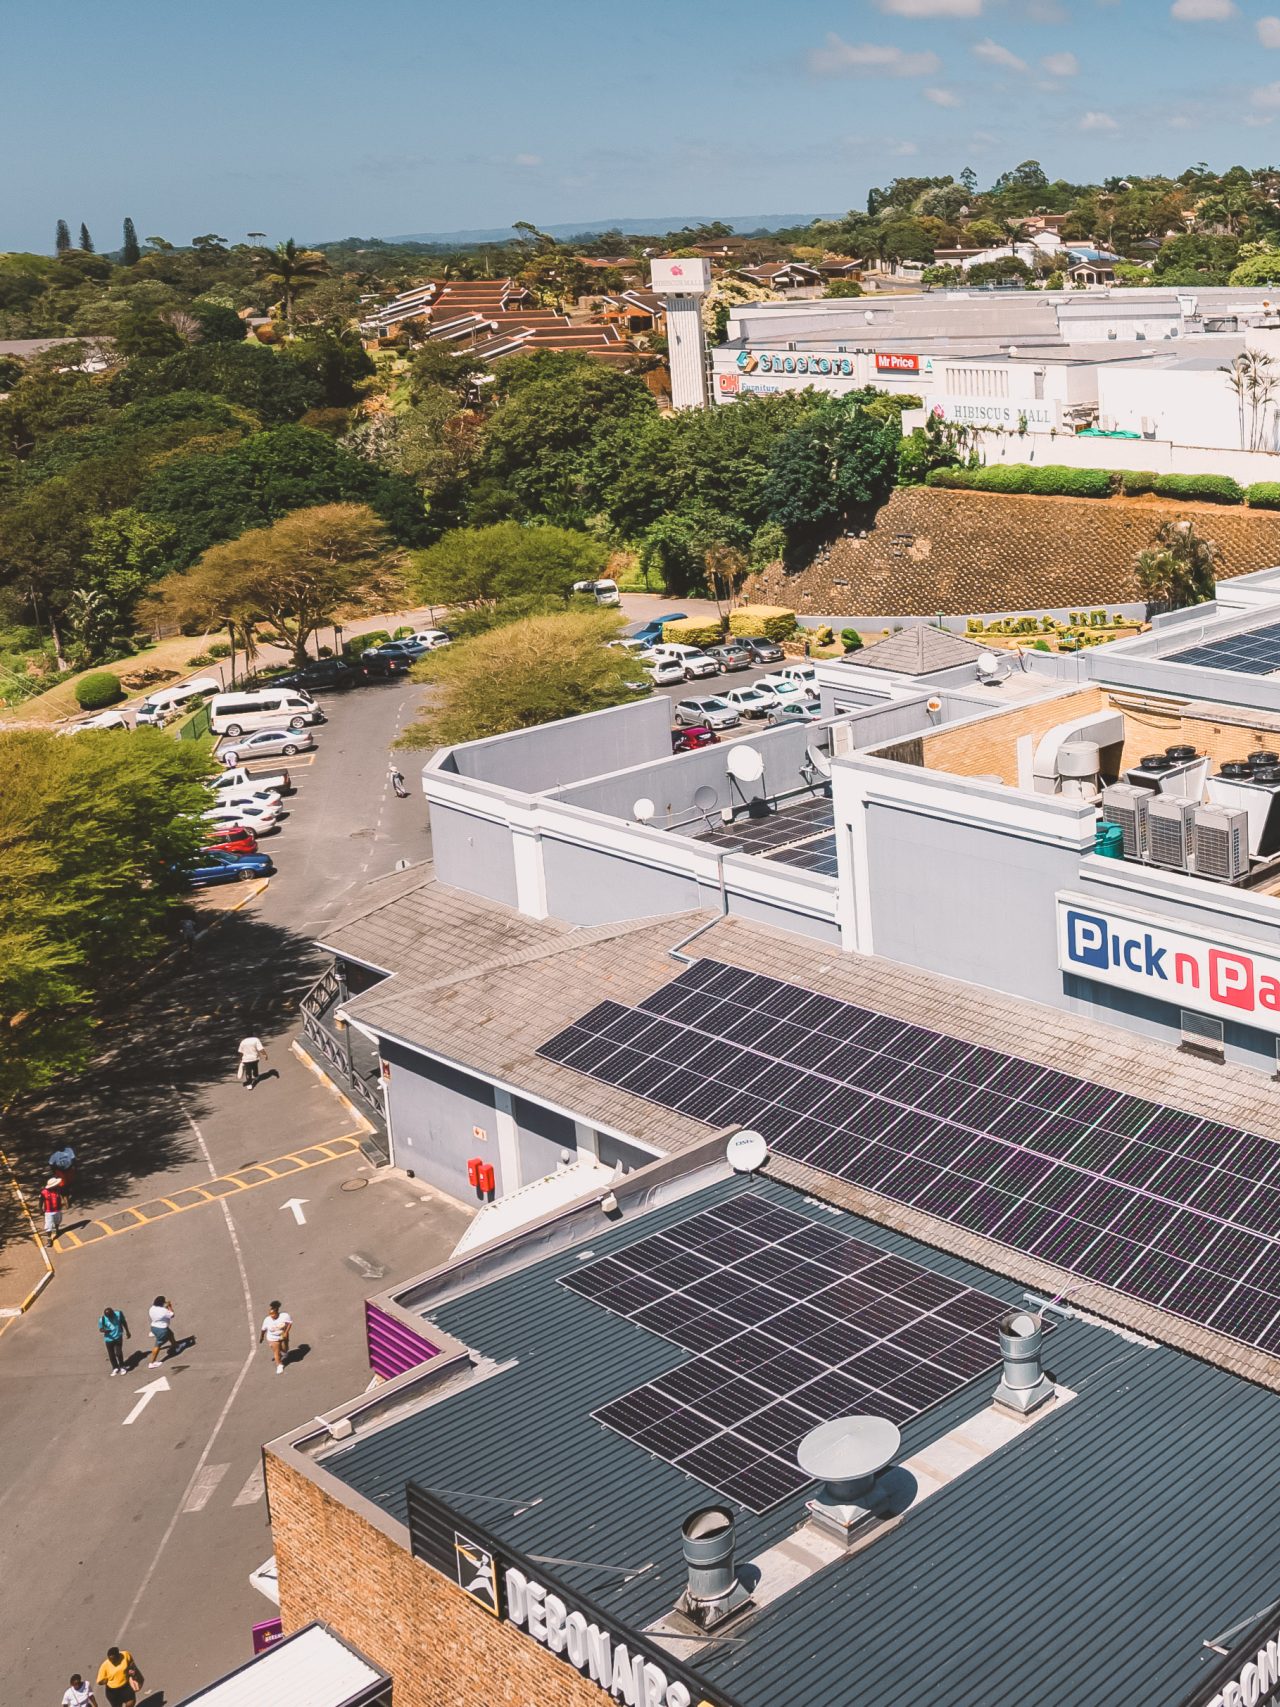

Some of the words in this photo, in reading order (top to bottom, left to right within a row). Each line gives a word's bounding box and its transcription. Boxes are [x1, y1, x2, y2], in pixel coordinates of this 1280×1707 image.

[760, 355, 853, 376] Checkers
[878, 356, 890, 367] Mr
[891, 356, 915, 368] Price
[720, 374, 739, 391] OK
[954, 405, 1010, 421] HIBISCUS
[1018, 409, 1051, 423] MALL
[1067, 910, 1168, 980] Pick
[1175, 952, 1200, 989] n
